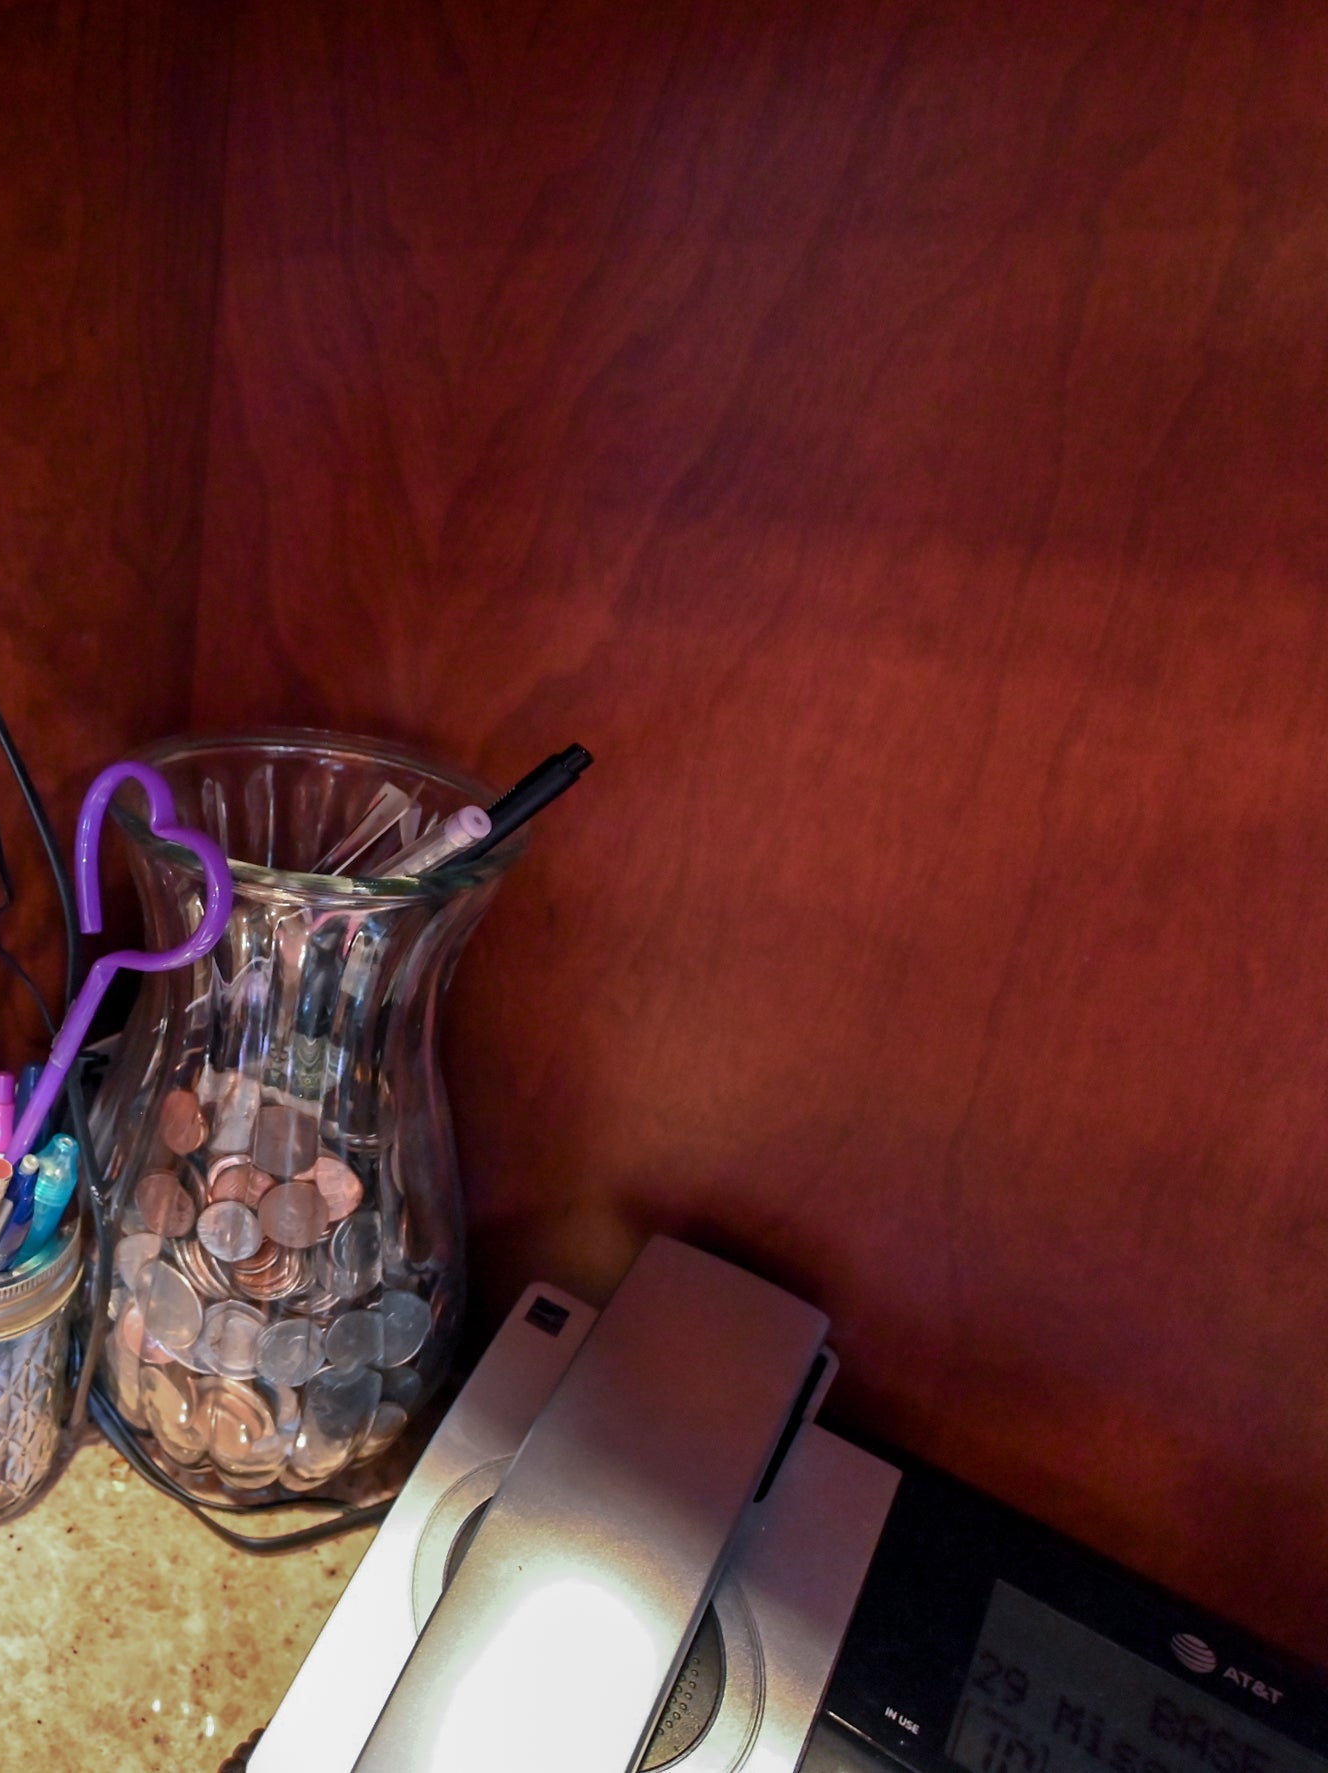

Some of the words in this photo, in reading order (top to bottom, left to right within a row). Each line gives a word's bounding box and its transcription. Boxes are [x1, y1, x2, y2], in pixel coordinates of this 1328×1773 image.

[972, 1650, 1030, 1706] 29
[1223, 1666, 1284, 1704] AT&T
[884, 1706, 898, 1720] IN
[898, 1715, 920, 1735] USE
